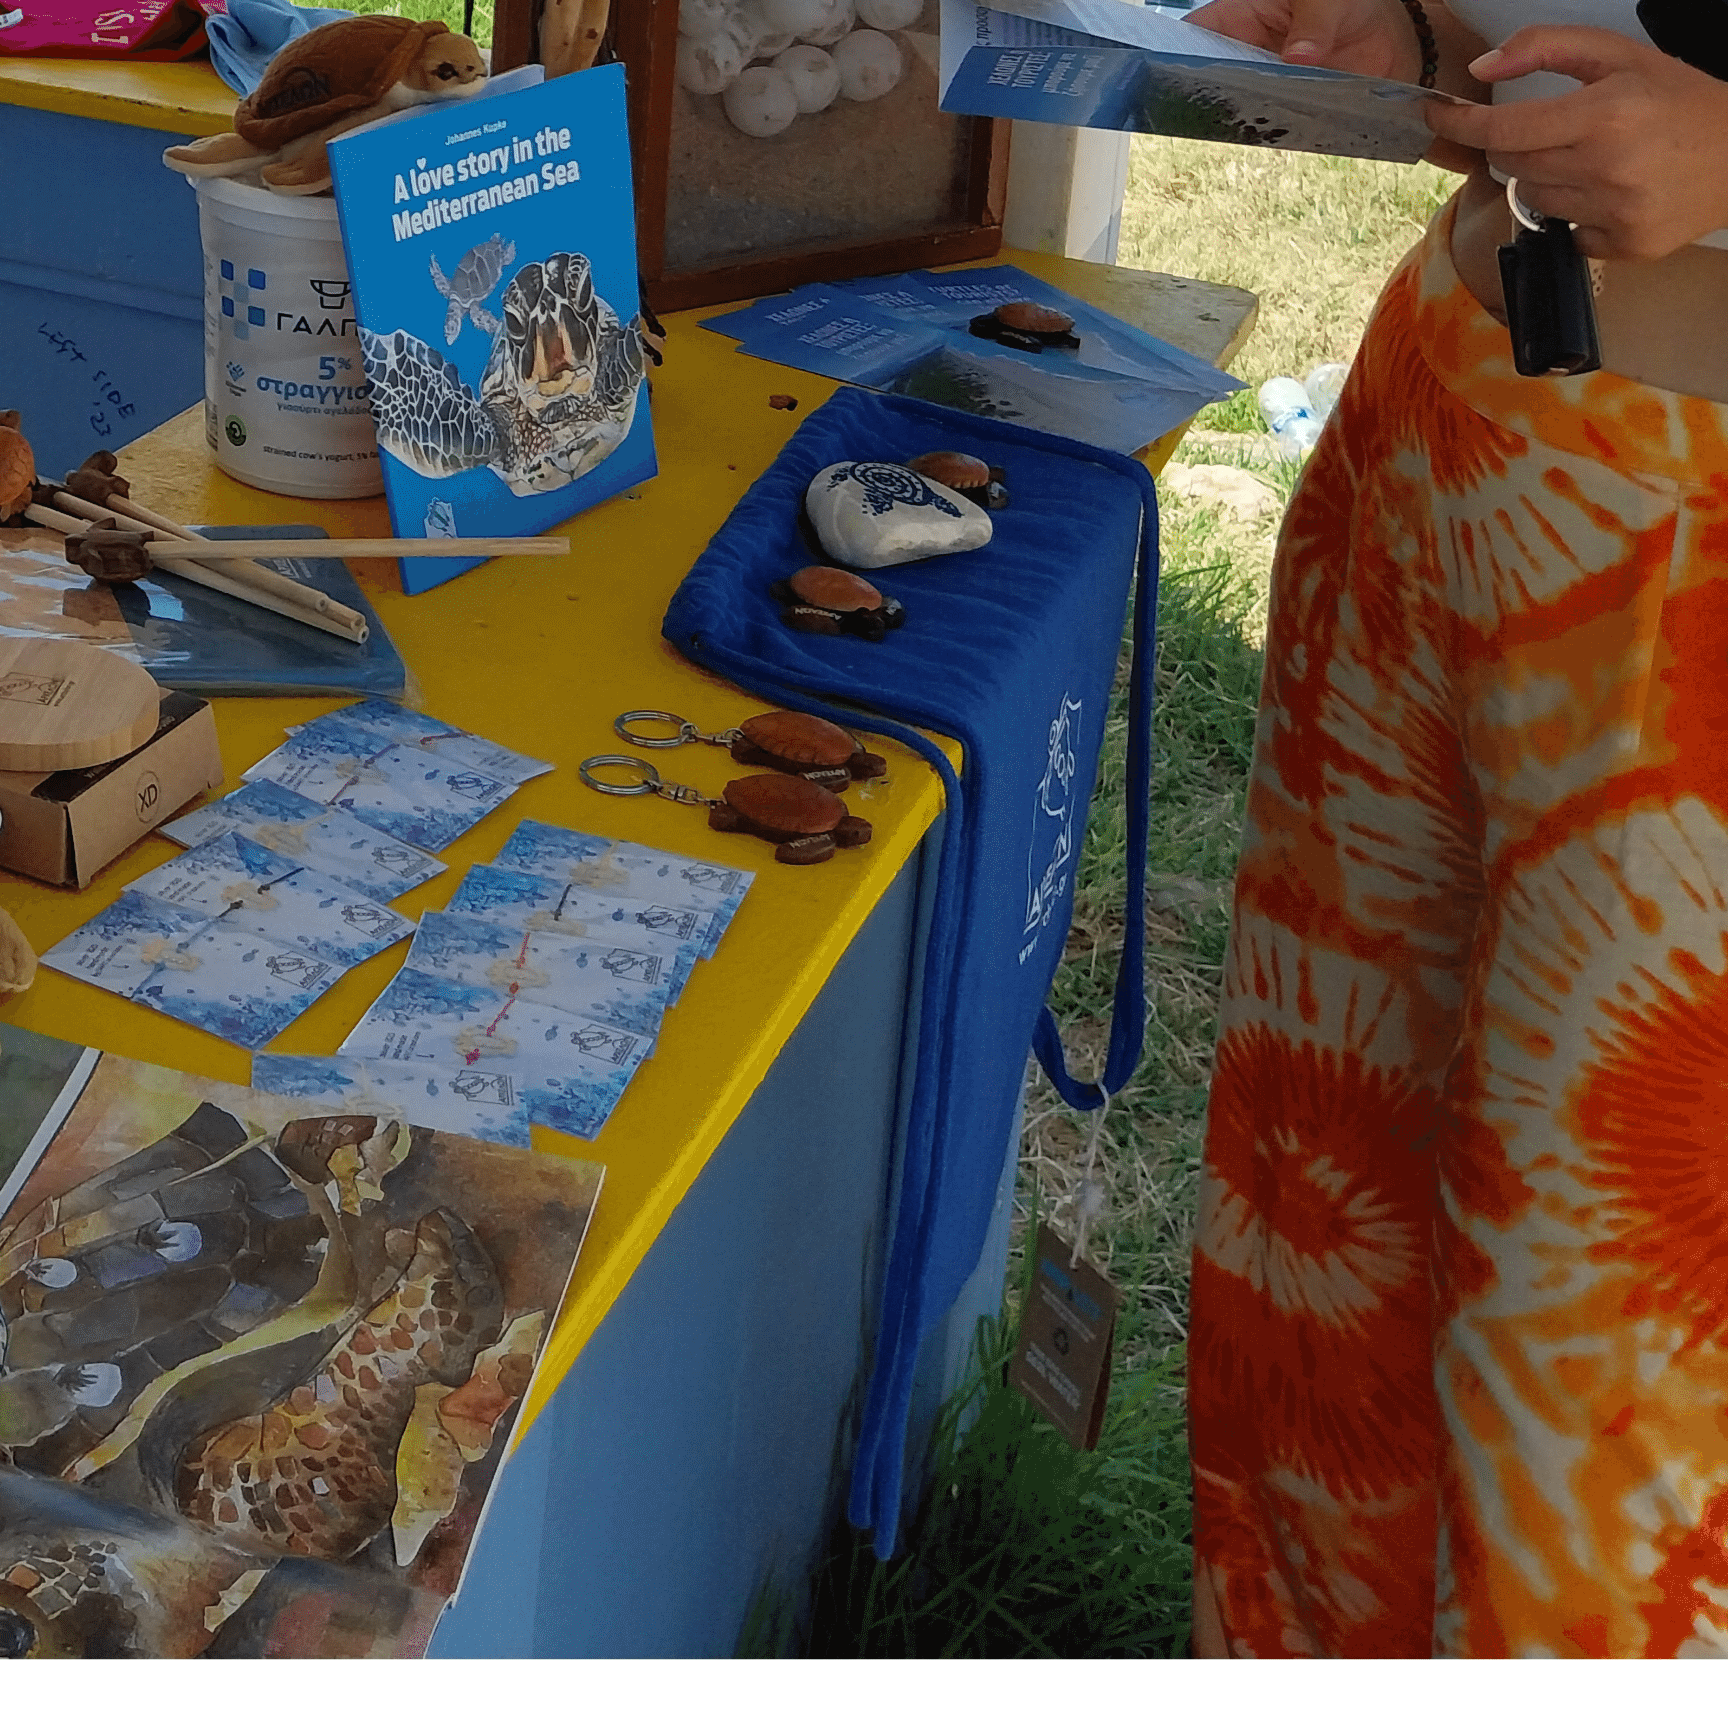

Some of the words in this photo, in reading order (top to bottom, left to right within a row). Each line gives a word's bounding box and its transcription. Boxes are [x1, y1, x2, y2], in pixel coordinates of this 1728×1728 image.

[394, 174, 410, 204] A
[410, 168, 455, 197] love
[457, 146, 510, 182] story
[512, 136, 534, 164] in
[535, 126, 571, 156] the
[392, 173, 540, 242] Mediterranean
[541, 161, 580, 191] Sea
[318, 355, 352, 381] 5%
[93, 370, 135, 419] SIDE
[137, 783, 158, 813] XD
